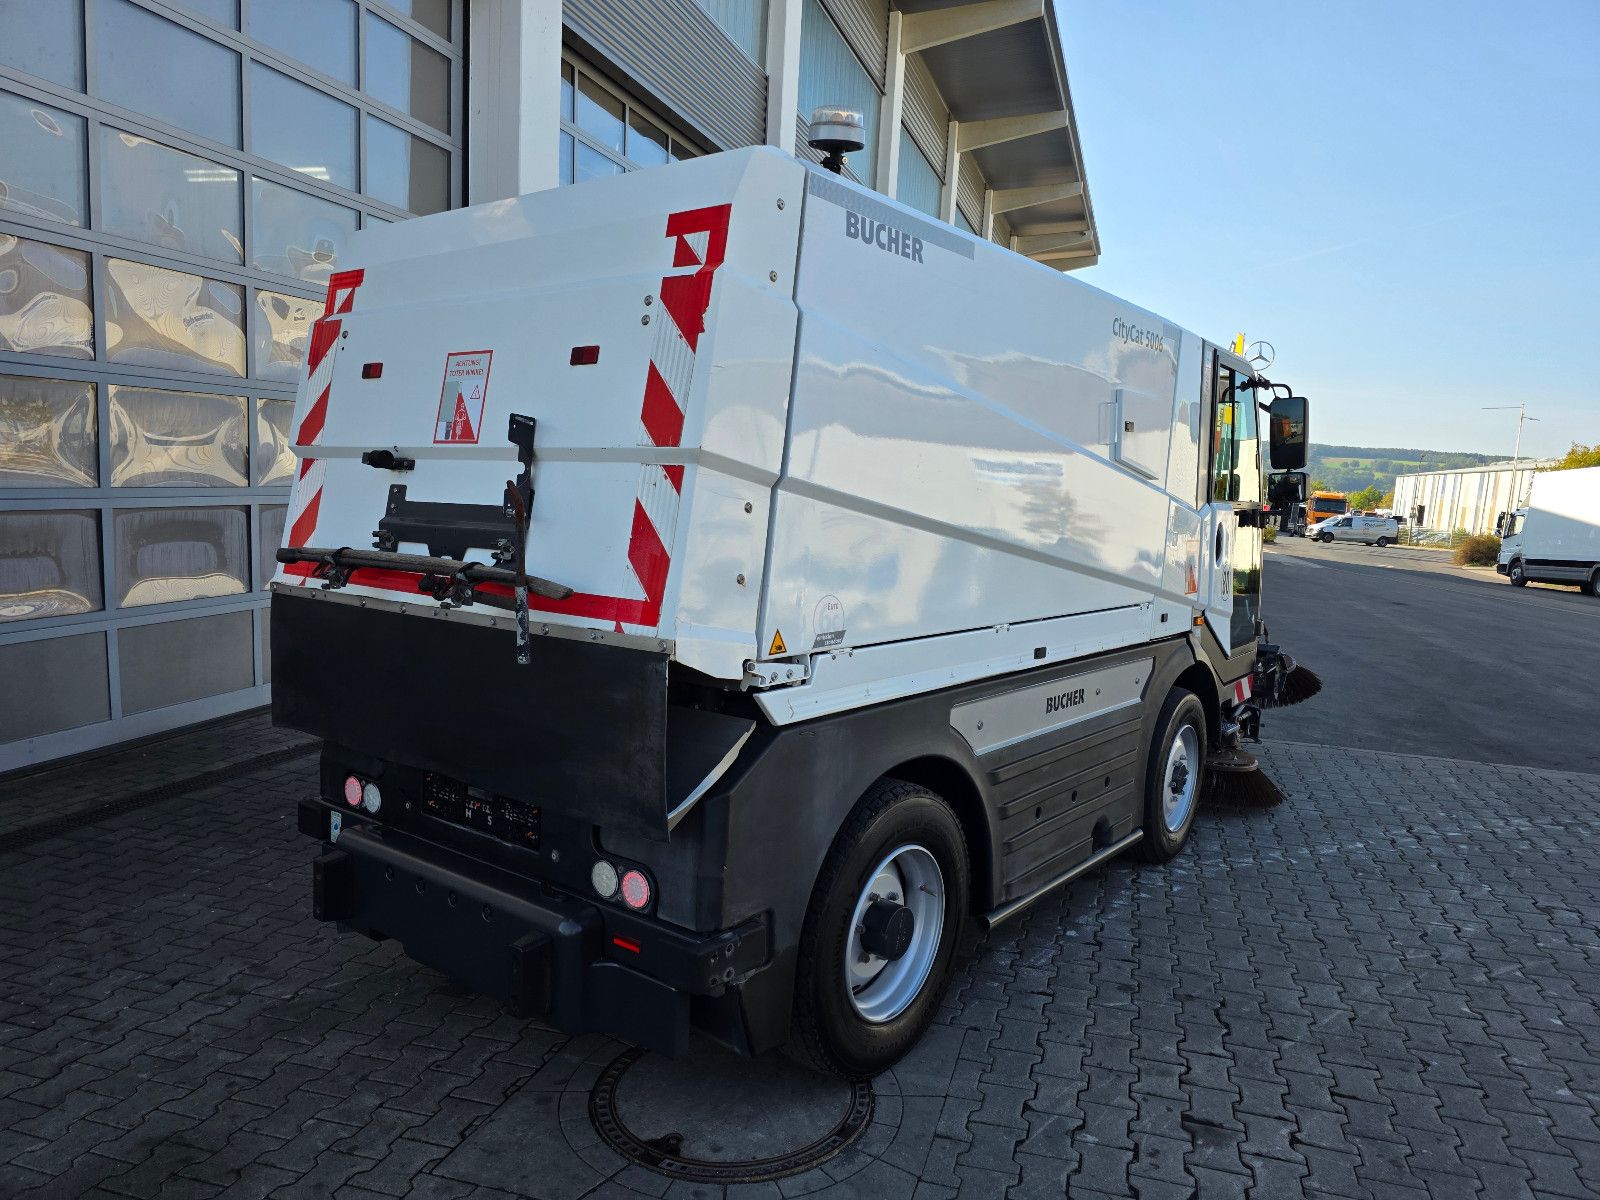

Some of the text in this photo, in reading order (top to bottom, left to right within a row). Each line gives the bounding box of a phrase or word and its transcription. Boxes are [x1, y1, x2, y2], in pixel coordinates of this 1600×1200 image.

[845, 210, 924, 265] BUCHER
[1112, 317, 1164, 353] CityCat 5006
[1045, 688, 1085, 715] BUCHER
